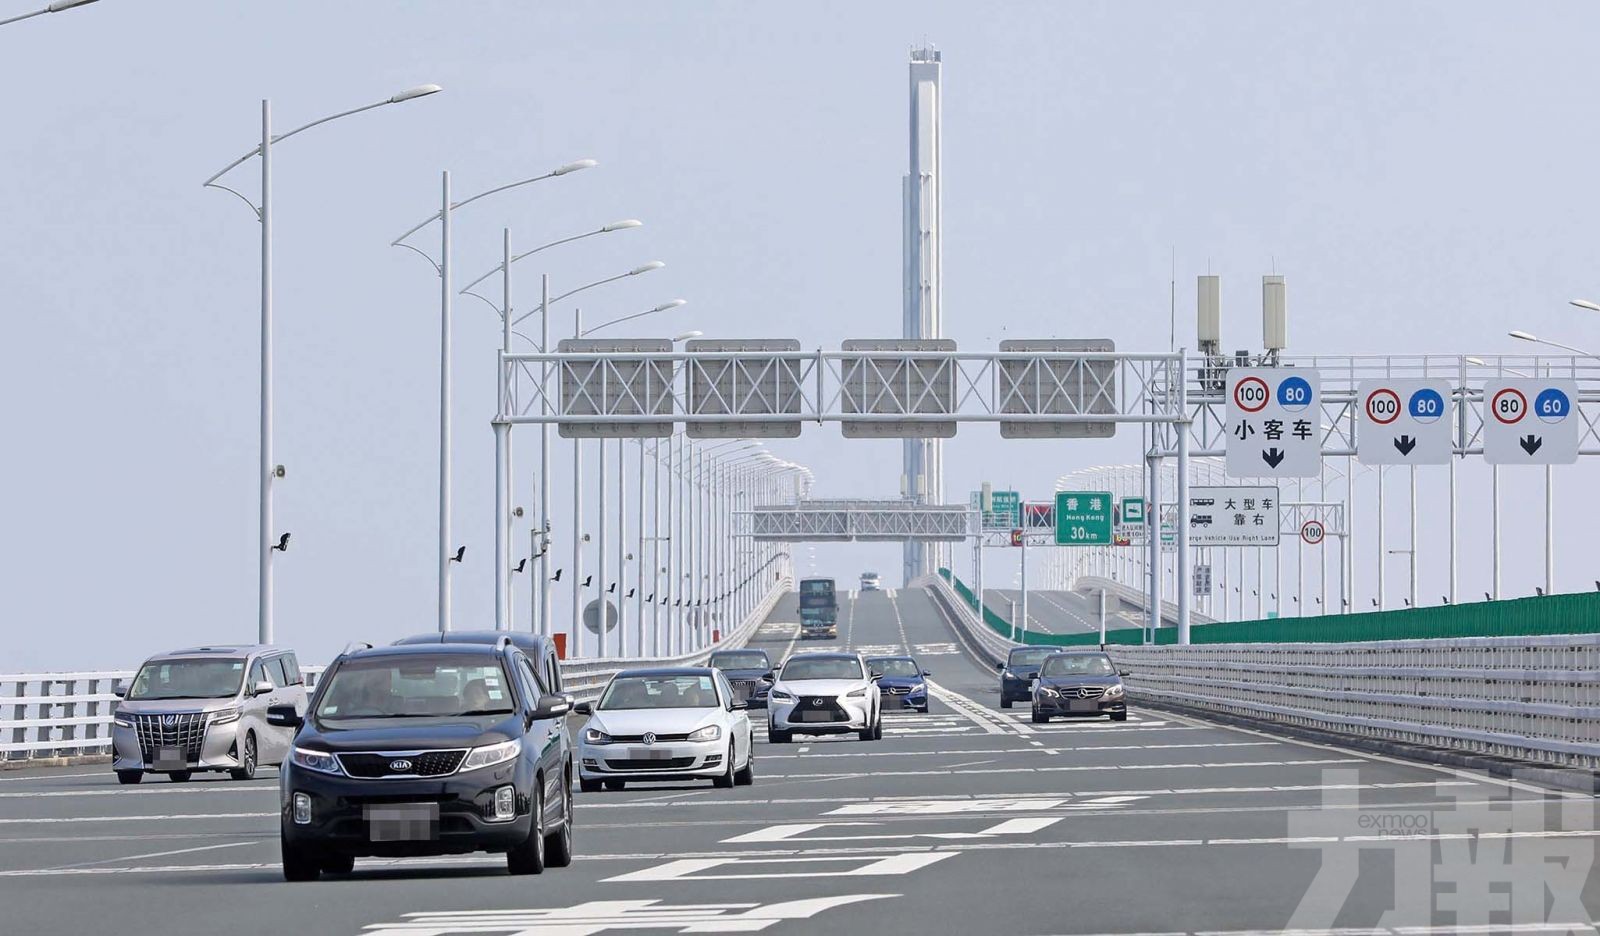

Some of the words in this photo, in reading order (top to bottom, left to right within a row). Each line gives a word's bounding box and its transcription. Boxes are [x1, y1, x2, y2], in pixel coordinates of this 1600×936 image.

[1240, 387, 1264, 401] 100
[1285, 387, 1305, 402] 80
[1371, 400, 1396, 414] 100
[1417, 399, 1437, 413] 80
[1500, 399, 1519, 413] 80
[1542, 399, 1562, 413] 60
[1234, 419, 1312, 440] 小客车
[1066, 498, 1102, 511] 香港
[1224, 498, 1273, 510] 大型车
[1233, 513, 1265, 526] 靠右
[1070, 526, 1098, 540] 30km
[1304, 528, 1321, 538] 100
[393, 761, 408, 769] KIA
